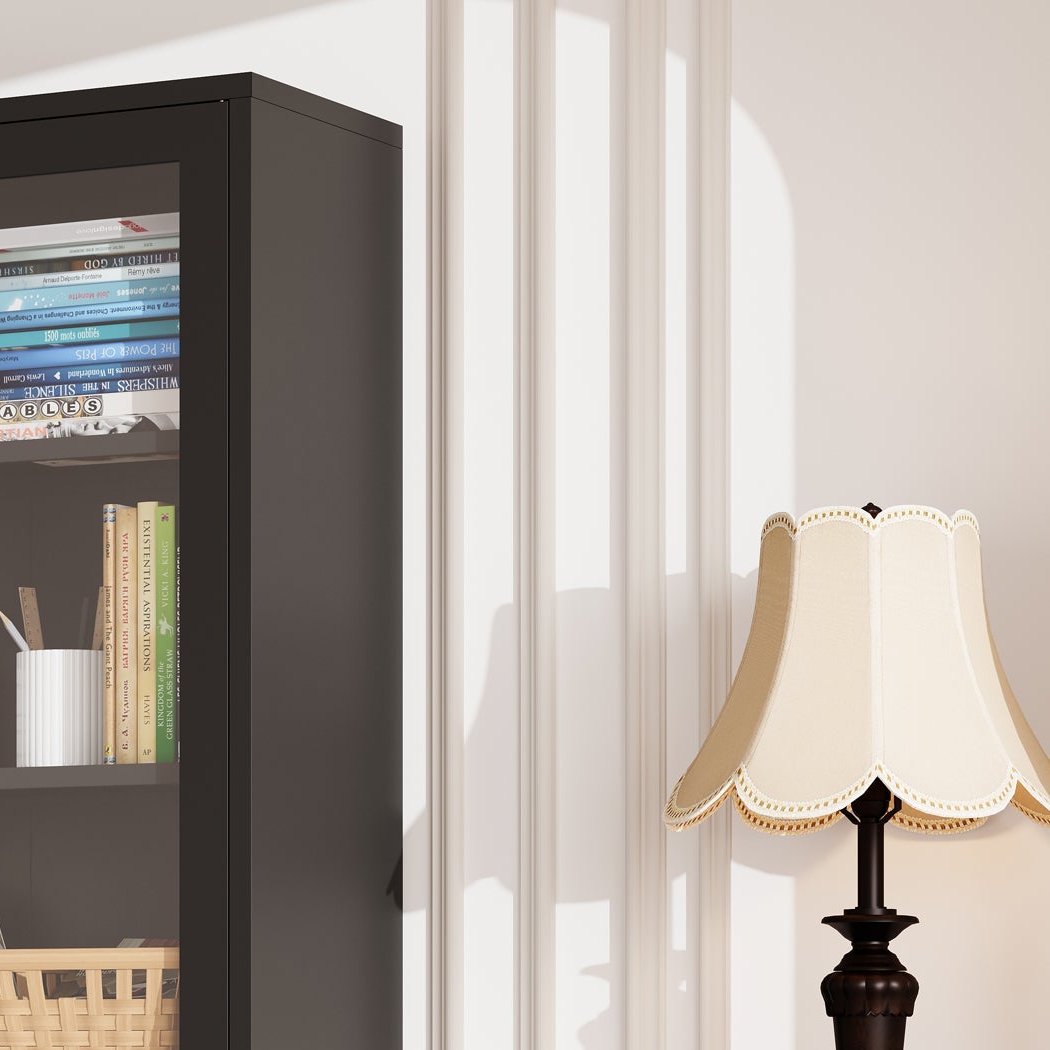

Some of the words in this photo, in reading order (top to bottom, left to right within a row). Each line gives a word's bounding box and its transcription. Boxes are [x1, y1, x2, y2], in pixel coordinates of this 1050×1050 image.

[84, 258, 108, 270] GOD
[112, 257, 124, 267] BY
[128, 253, 162, 265] HIRED
[117, 286, 147, 297] Joneses
[108, 305, 145, 313] Environment:
[6, 314, 33, 322] Changing
[44, 311, 74, 320] Challenges
[44, 329, 59, 342] 1500
[60, 331, 76, 340] mots
[77, 327, 100, 339] oubliés
[107, 368, 114, 376] In
[115, 365, 150, 374] Adventures
[152, 363, 173, 372] Alice's
[26, 373, 46, 381] Lewis
[67, 368, 107, 379] Wonderland
[3, 374, 26, 384] Carroll
[117, 376, 179, 392] WHISPERS
[82, 383, 99, 392] THE
[101, 381, 111, 390] IN
[24, 384, 76, 399] SILENCE
[143, 520, 151, 592] EXISTENTIAL
[143, 600, 151, 672] ASPIRATIONS
[157, 673, 166, 682] of
[143, 695, 151, 726] HAYES
